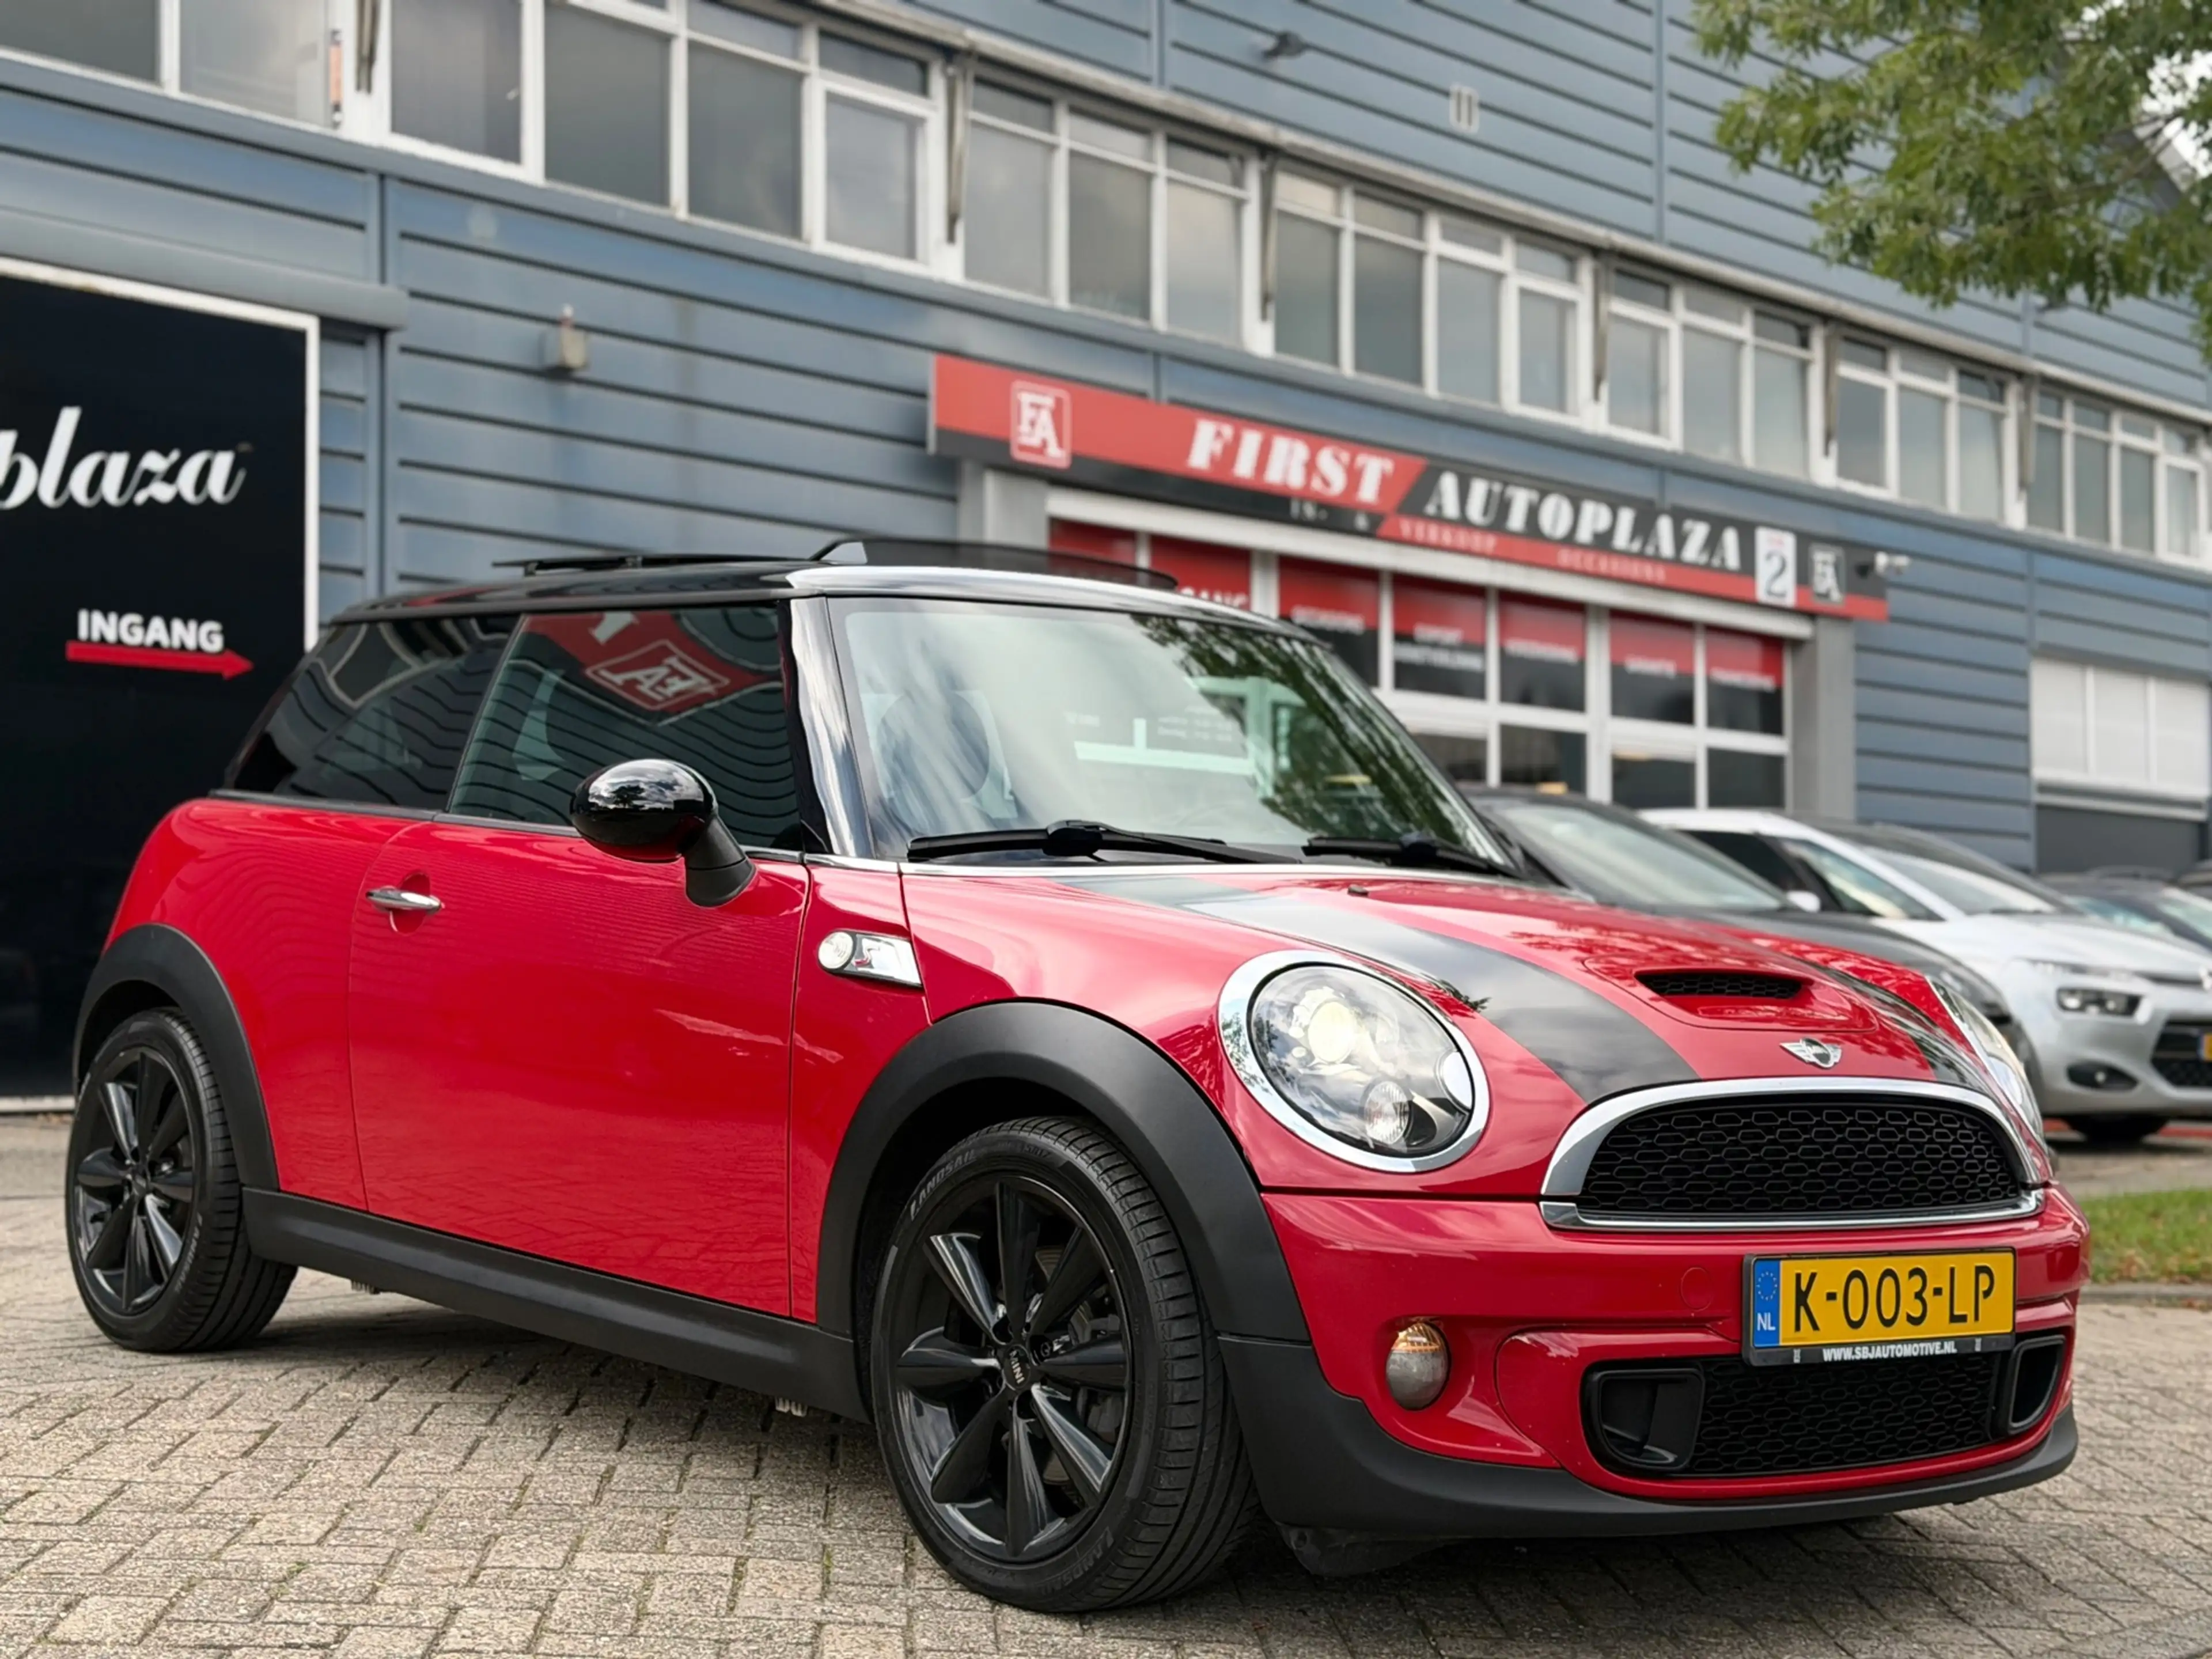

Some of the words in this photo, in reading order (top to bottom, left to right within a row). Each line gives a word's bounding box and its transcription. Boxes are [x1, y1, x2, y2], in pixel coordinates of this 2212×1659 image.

[1188, 417, 1395, 505] FIRST
[1425, 470, 1741, 570] AUTOPLAZA
[1764, 550, 1789, 598] 2
[77, 608, 224, 653] INGANG
[909, 1149, 979, 1222] LANDSAIL
[1794, 1264, 1995, 1332] K-003-LP
[1756, 1312, 1776, 1331] NL
[1009, 1350, 1025, 1385] MINI
[1822, 1340, 1958, 1362] WWW.SBJAUTOMOTIVE.NL
